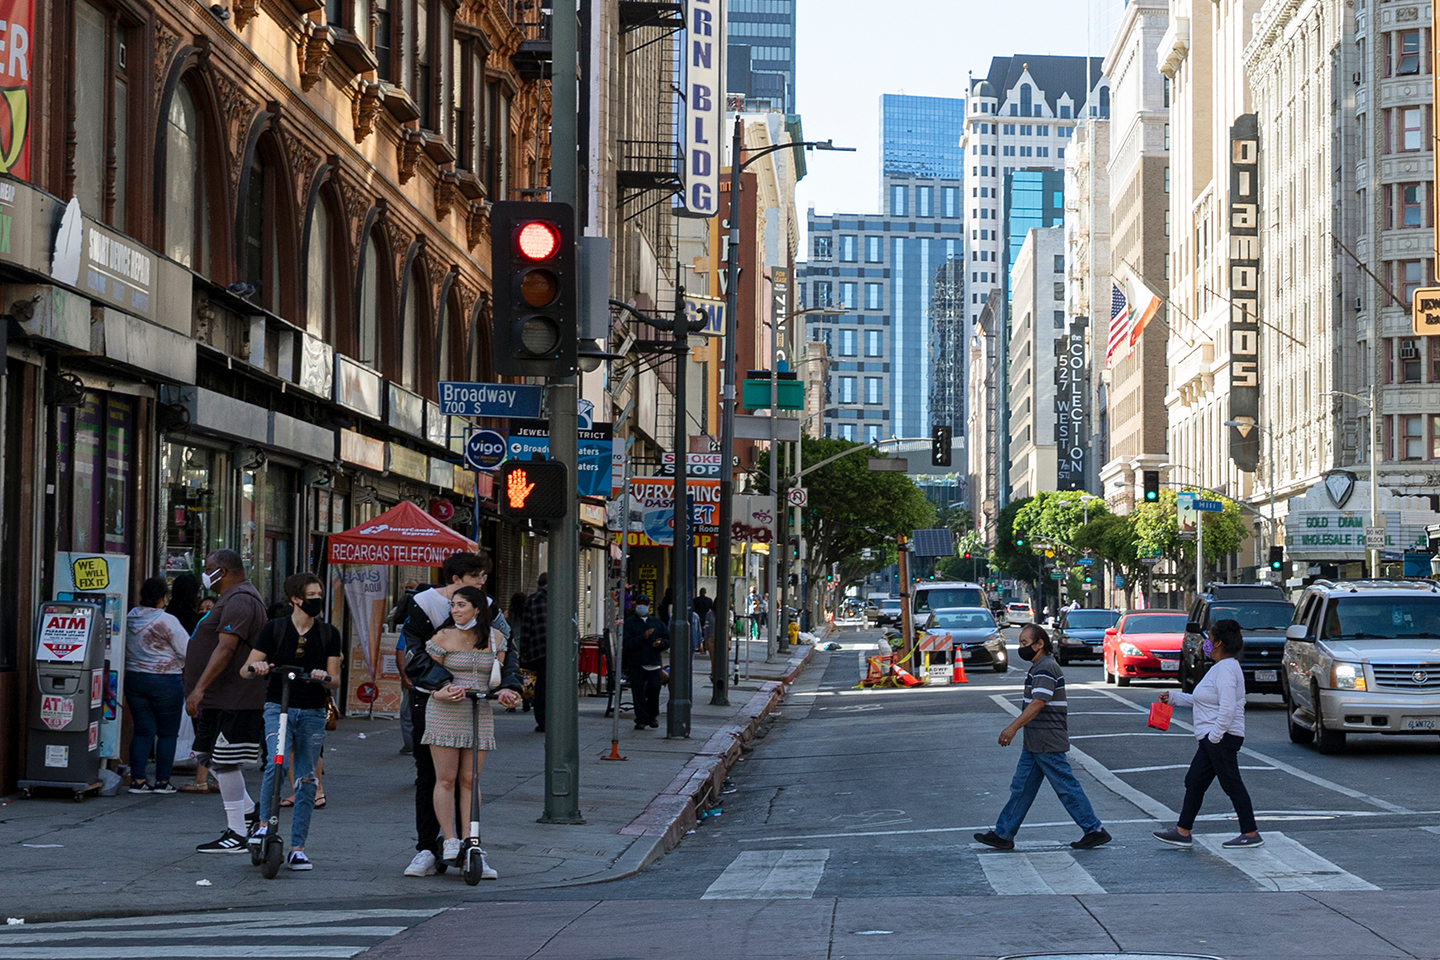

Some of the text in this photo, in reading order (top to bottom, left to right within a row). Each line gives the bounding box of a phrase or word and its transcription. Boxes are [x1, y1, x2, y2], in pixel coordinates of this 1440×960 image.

[691, 83, 713, 211] BLDG
[1058, 355, 1069, 391] 527
[443, 384, 516, 407] Broadway
[444, 402, 482, 414] 700 S
[1070, 343, 1084, 473] COLLECTION
[1057, 400, 1071, 450] WEST
[471, 439, 503, 455] vigo
[664, 453, 721, 463] SOKE
[664, 465, 720, 475] SOP
[628, 483, 721, 503] EVERYHING
[1198, 501, 1216, 509] Hill
[1306, 516, 1329, 528] GOLD
[1301, 534, 1352, 546] WHOLESALE
[331, 543, 390, 562] RECARGAS
[78, 560, 94, 570] WE
[85, 569, 105, 577] WILL
[79, 578, 104, 587] FIX IT
[47, 616, 86, 629] ATM
